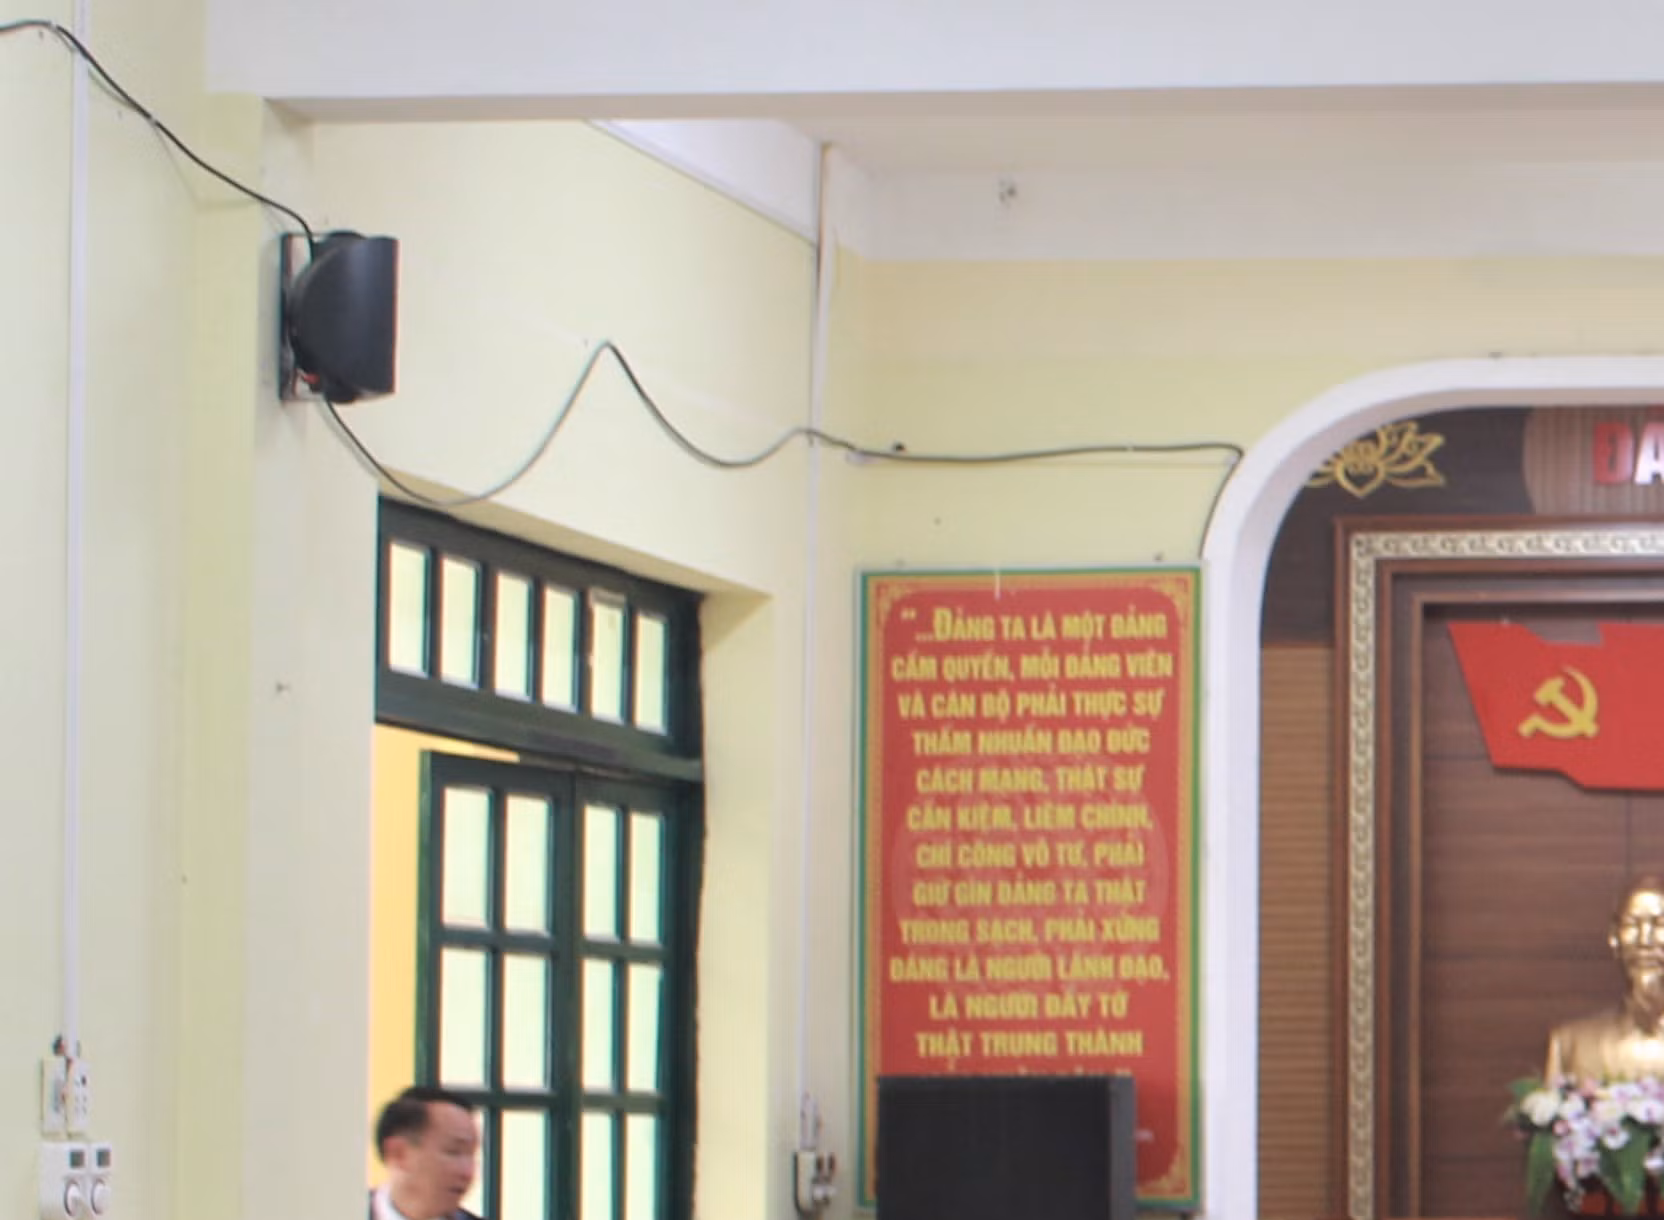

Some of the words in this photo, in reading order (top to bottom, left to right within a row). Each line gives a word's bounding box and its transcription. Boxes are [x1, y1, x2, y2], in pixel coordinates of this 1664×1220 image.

[1001, 616, 1025, 640] TA
[1031, 612, 1056, 640] LÀ
[899, 692, 925, 717] VÀ
[1062, 878, 1090, 908] TA
[900, 919, 970, 944] TRONG
[954, 954, 981, 982] LÀ
[930, 992, 958, 1018] LÀ
[981, 1032, 1057, 1056] TRUNG
